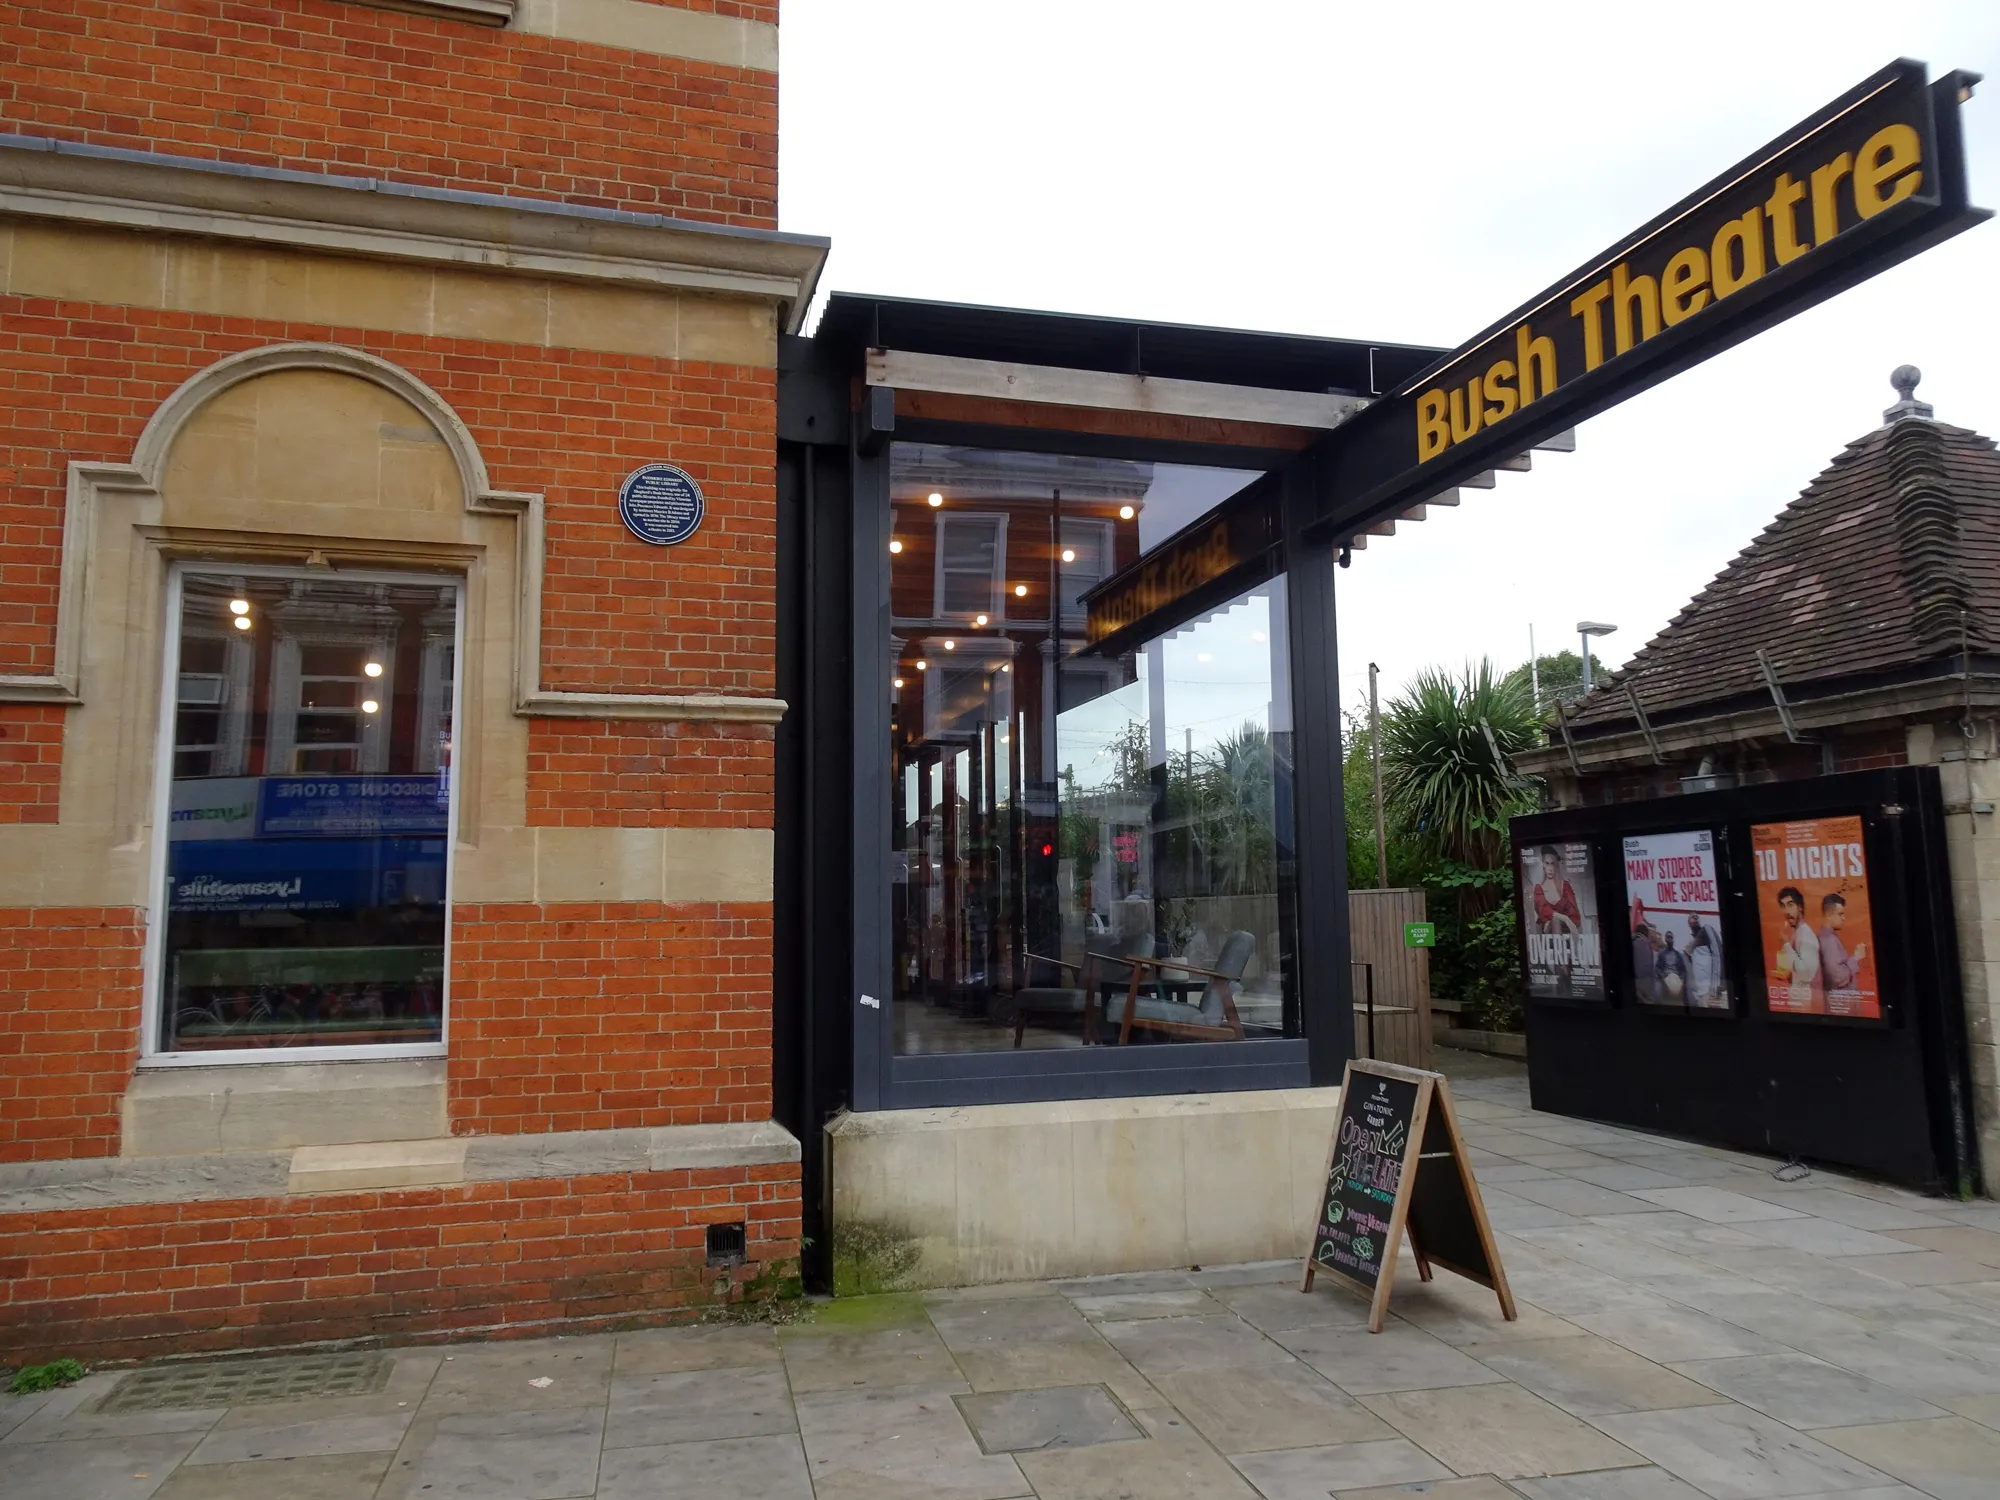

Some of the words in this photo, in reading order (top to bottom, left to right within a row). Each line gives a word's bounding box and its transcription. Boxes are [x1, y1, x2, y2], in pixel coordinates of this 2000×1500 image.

[1416, 324, 1559, 465] Bush
[1571, 123, 1925, 374] Theatre
[1521, 847, 1535, 857] Bush
[1625, 840, 1640, 848] Bush
[1625, 849, 1648, 857] Theatre
[1626, 859, 1655, 881] MANY
[1658, 855, 1703, 879] STORIES
[1755, 849, 1779, 881] 10
[1784, 843, 1863, 880] NIGHTS
[1657, 881, 1678, 903] ONE
[1680, 880, 1716, 903] SPACE
[1529, 933, 1600, 966] OVERFLOW
[1366, 1114, 1384, 1127] GARDEN
